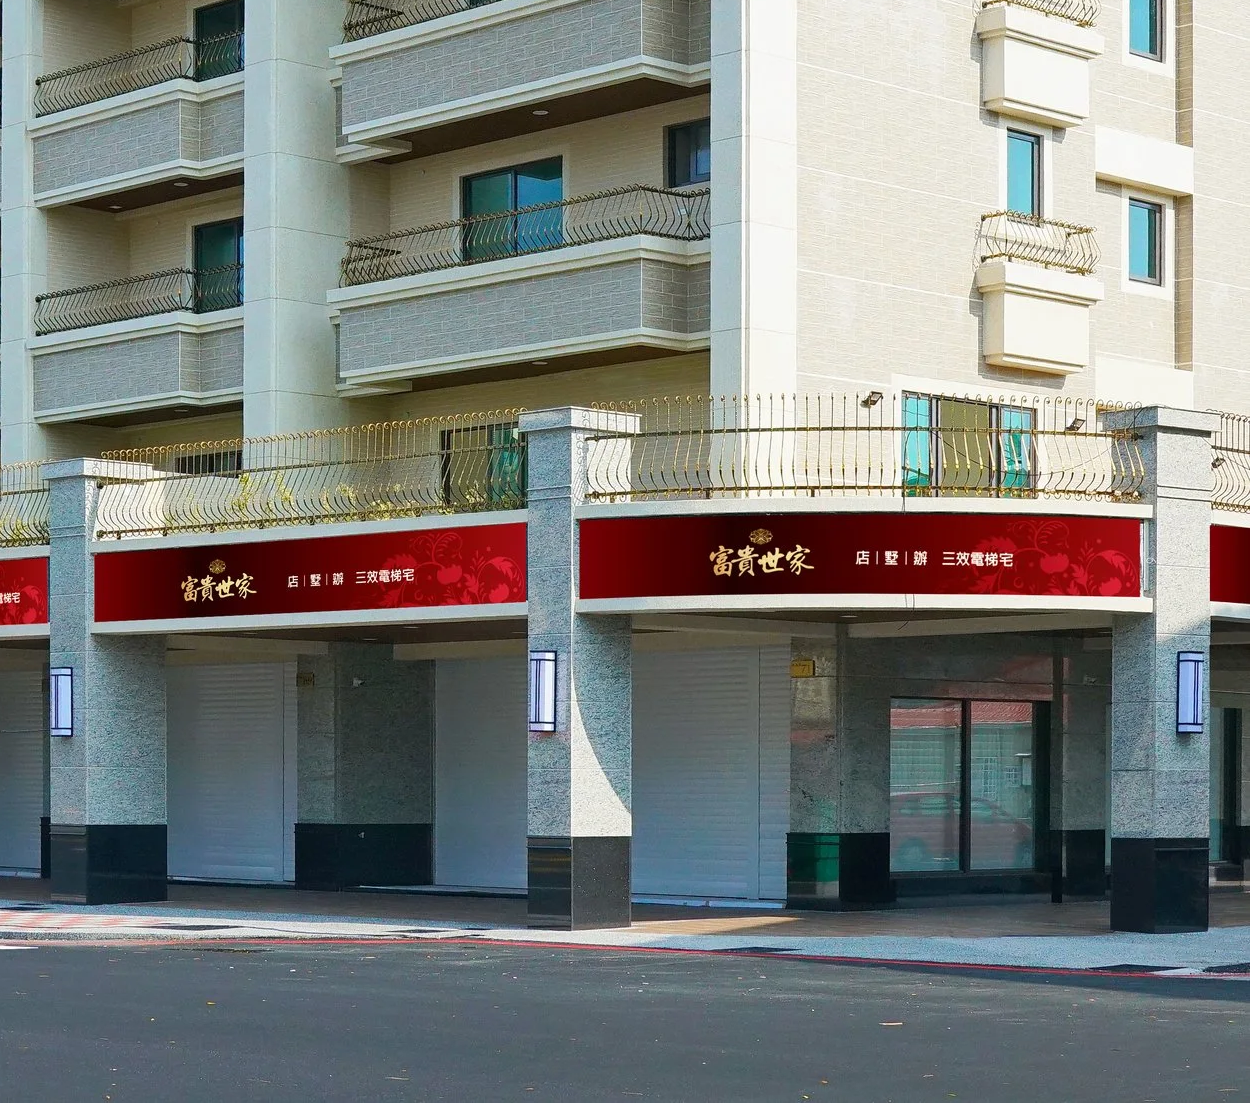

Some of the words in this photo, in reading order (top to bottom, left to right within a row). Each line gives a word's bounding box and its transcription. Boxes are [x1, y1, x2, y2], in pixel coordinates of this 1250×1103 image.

[709, 544, 815, 577] 富貴世家
[941, 551, 1014, 568] 三效電梯宅
[180, 572, 257, 603] 富貴世家
[355, 568, 415, 584] 三效電梯宅
